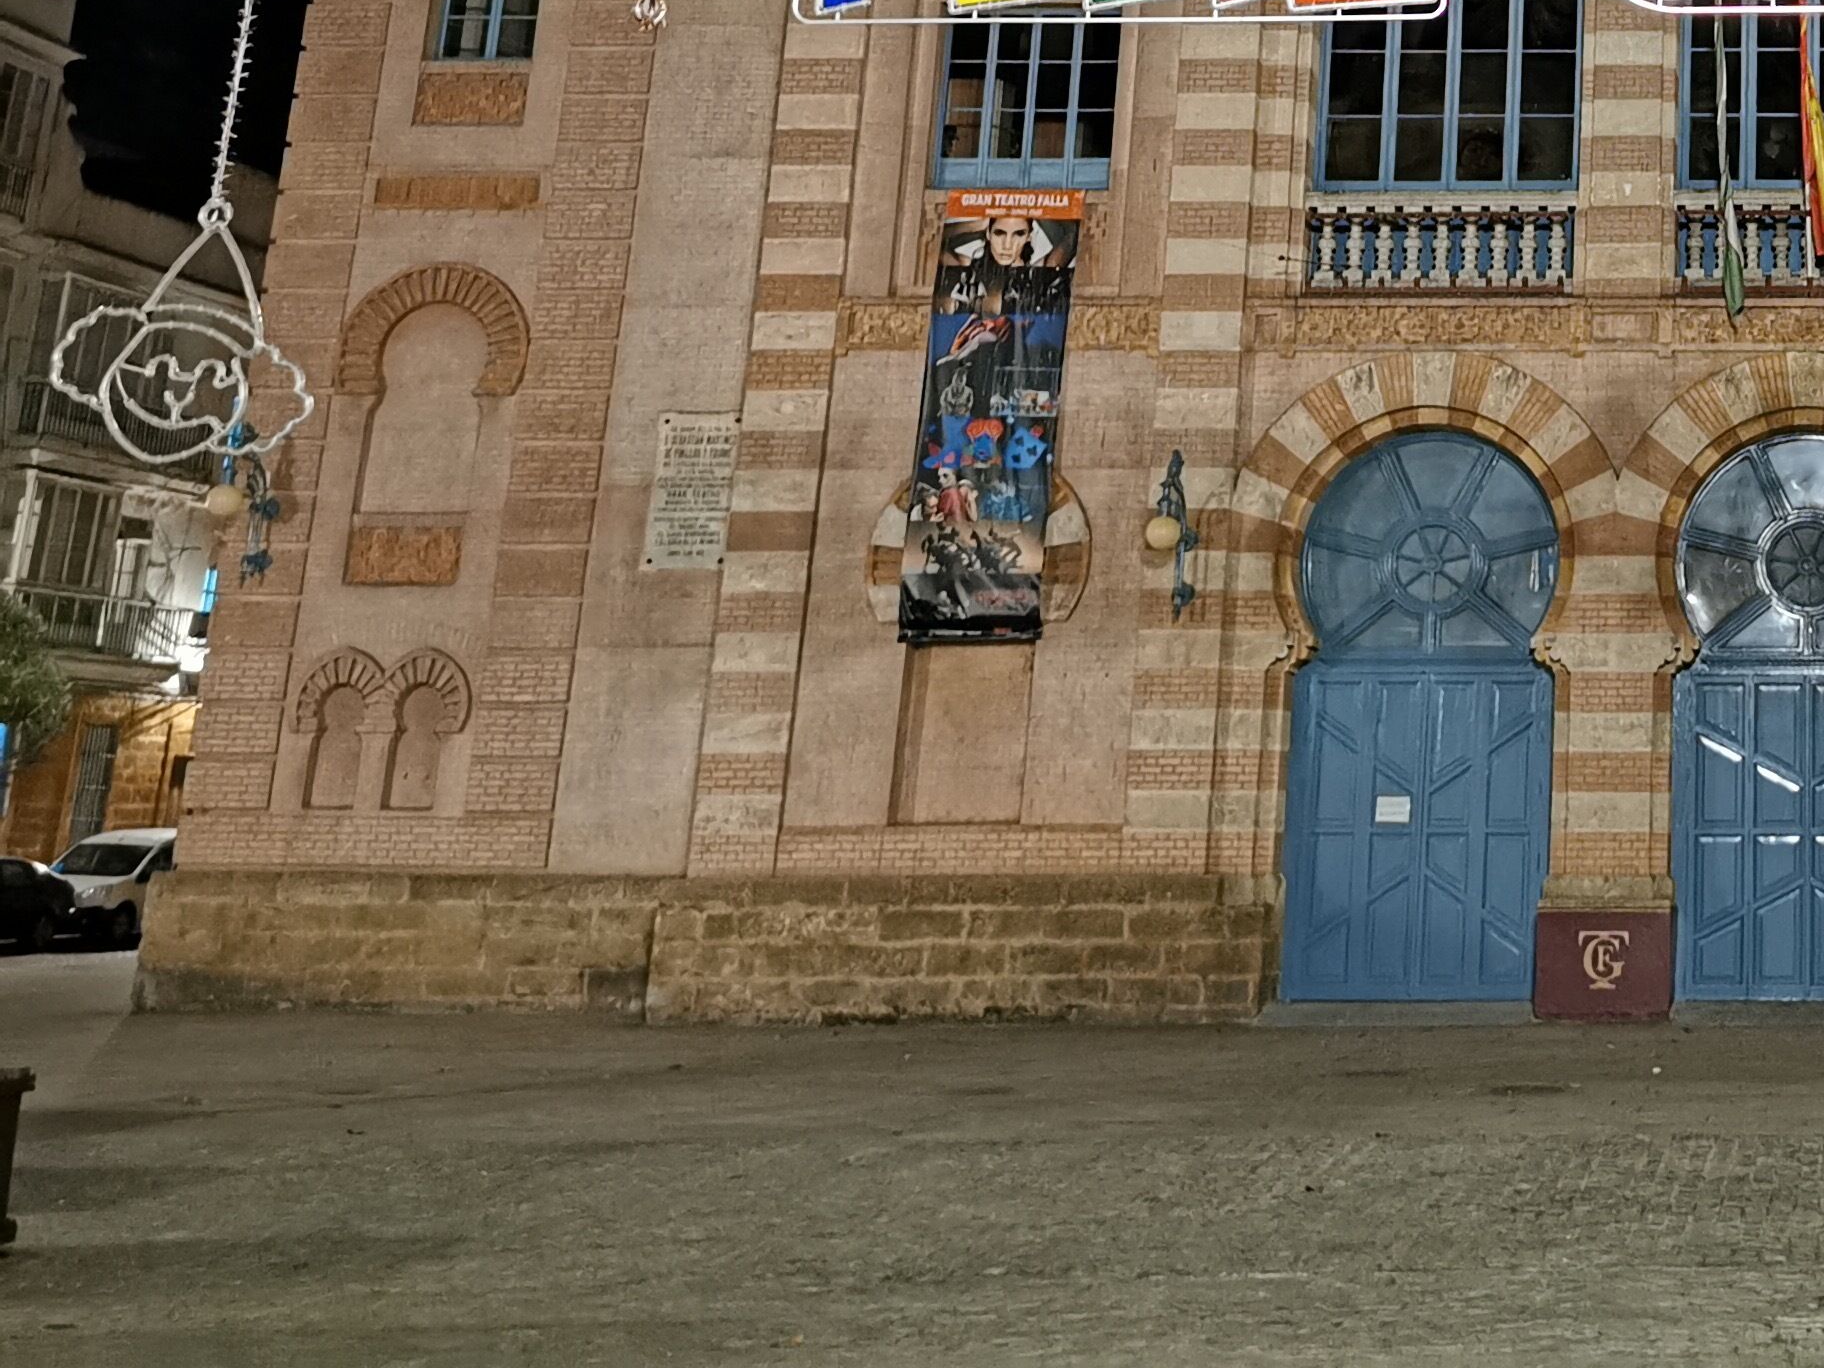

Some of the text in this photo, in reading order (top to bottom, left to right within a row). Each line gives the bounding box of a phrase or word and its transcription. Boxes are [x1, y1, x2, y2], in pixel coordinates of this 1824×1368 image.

[961, 193, 1069, 207] GRAN TEATRO FALLA
